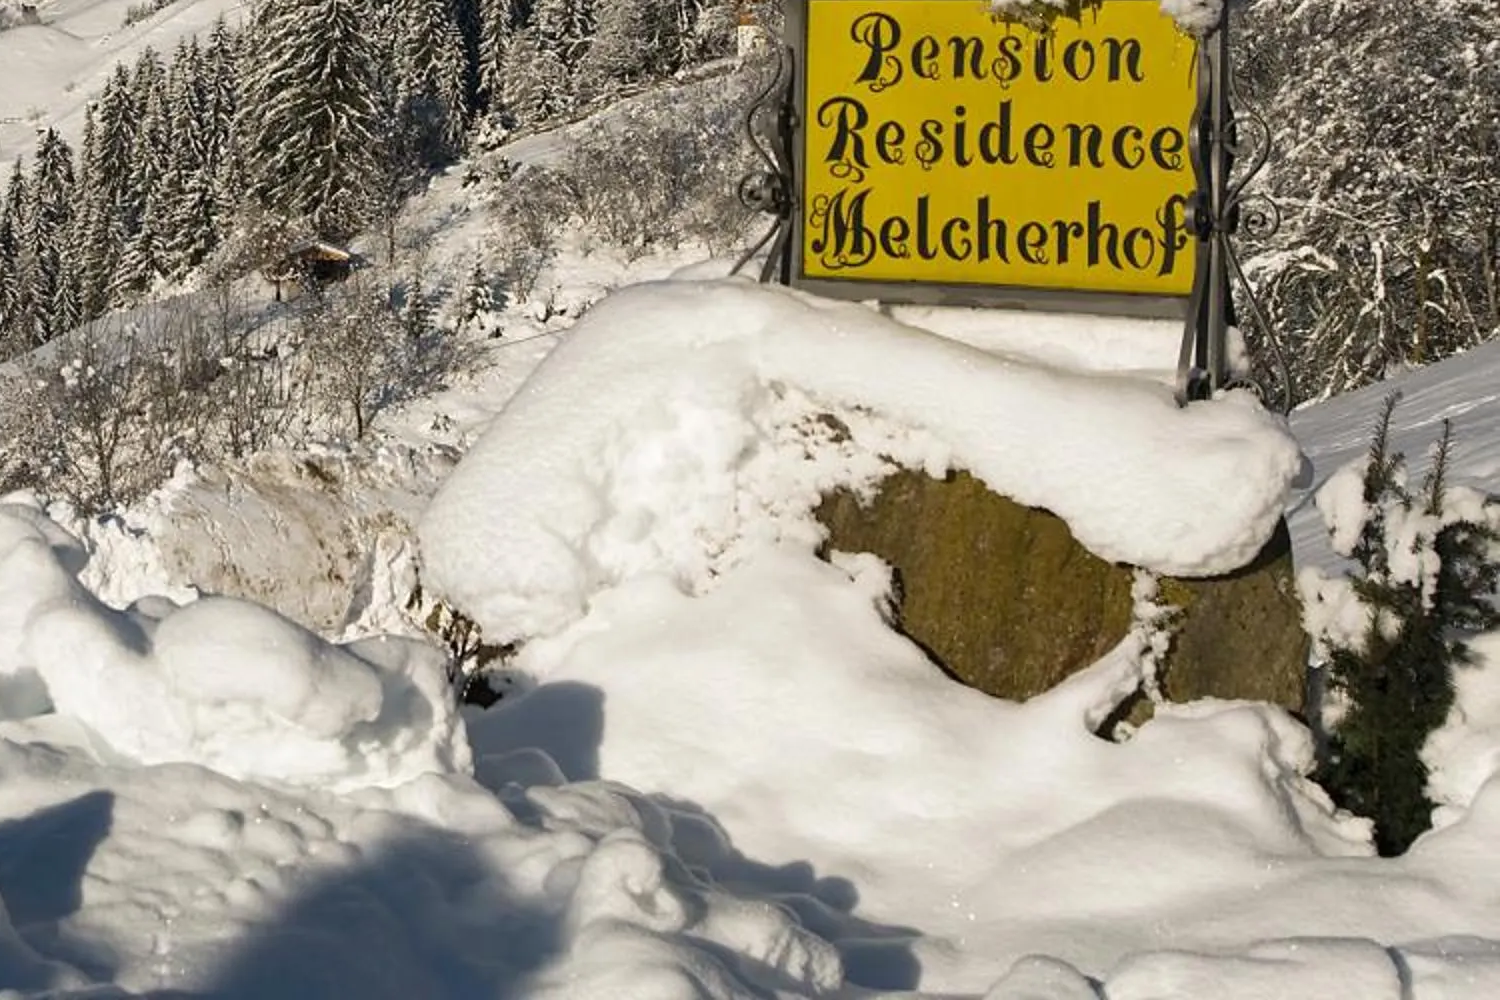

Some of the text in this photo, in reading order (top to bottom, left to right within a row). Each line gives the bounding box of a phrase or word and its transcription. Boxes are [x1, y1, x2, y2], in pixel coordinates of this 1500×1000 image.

[850, 12, 1145, 92] Pension
[816, 96, 1184, 183] Residence
[810, 187, 1190, 277] Melcherhof
